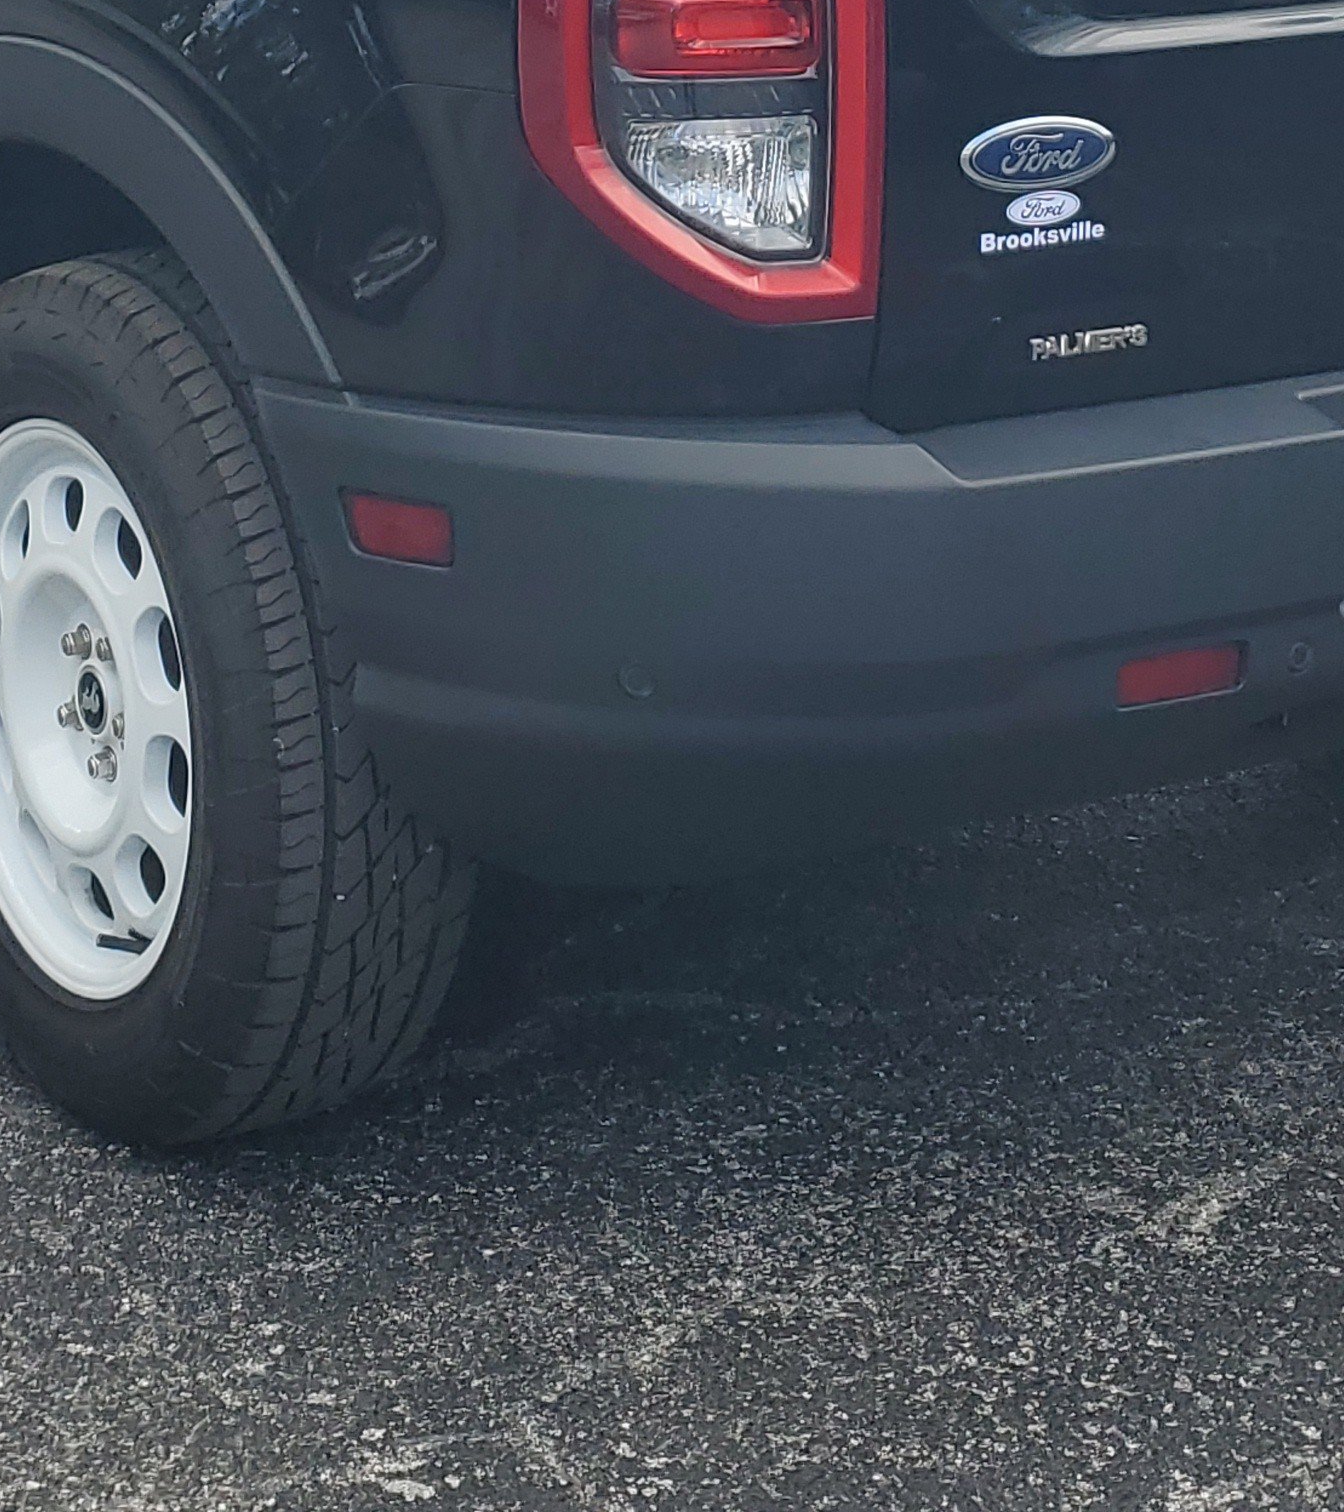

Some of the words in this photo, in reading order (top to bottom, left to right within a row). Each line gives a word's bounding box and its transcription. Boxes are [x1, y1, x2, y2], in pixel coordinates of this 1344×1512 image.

[1001, 132, 1085, 176] Ford
[1020, 196, 1066, 220] Ford
[979, 219, 1106, 254] Brooksville
